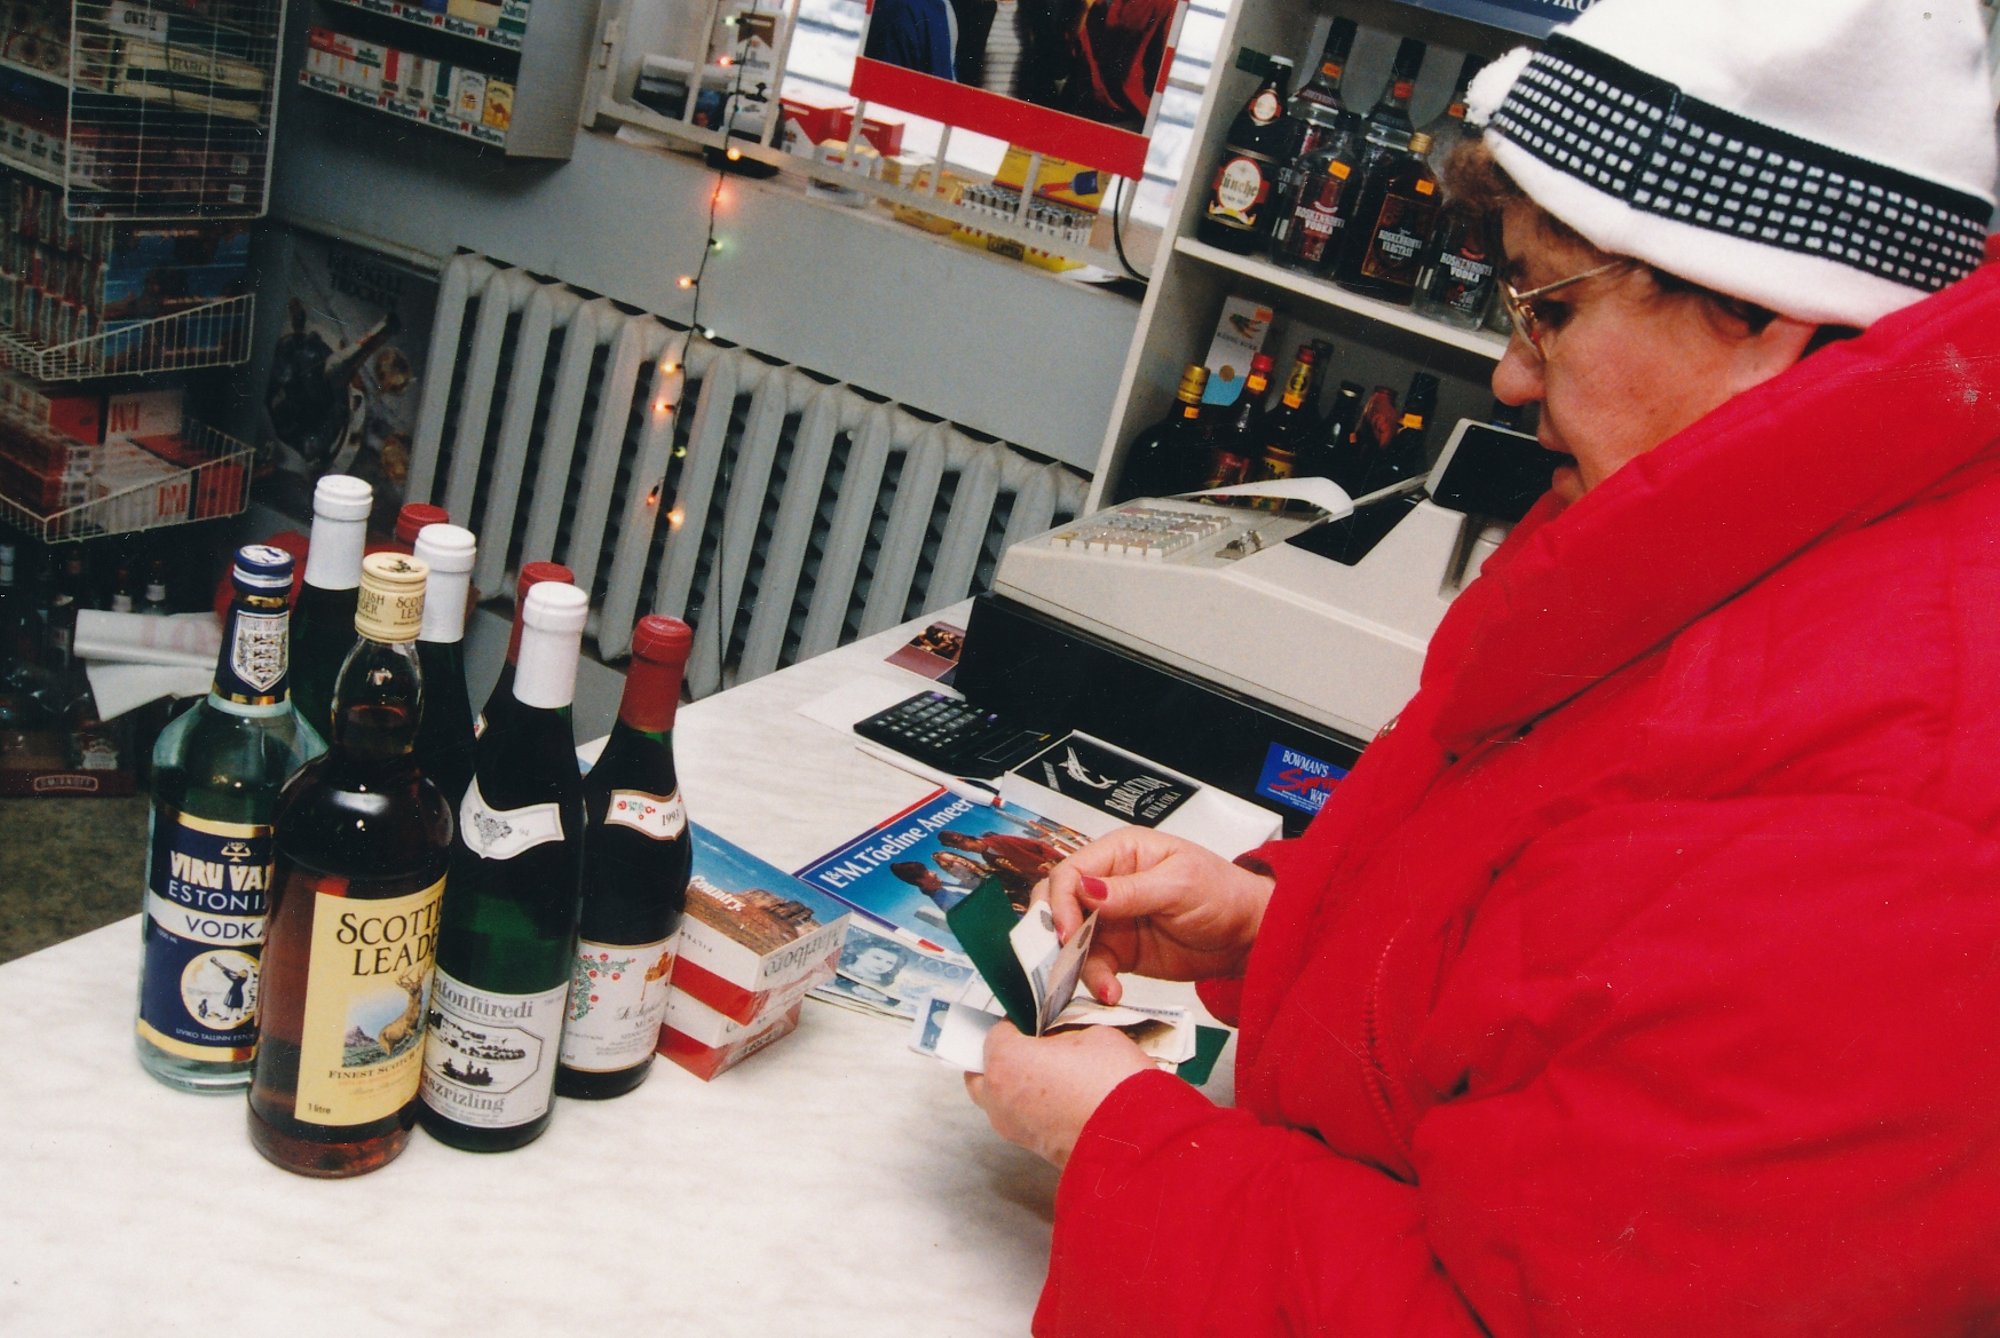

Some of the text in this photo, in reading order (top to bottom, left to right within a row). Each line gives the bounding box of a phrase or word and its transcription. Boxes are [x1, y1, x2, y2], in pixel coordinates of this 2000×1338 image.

[1450, 266, 1480, 284] VODKA
[1282, 750, 1329, 778] BOWMAN'S
[1104, 774, 1173, 817] BARRACUDA
[1310, 788, 1330, 807] WAT
[917, 799, 975, 833] Ameer
[170, 850, 224, 890] VIRU
[168, 880, 265, 910] ESTONI
[336, 895, 441, 945] SCOTTI
[352, 924, 440, 976] LEADE
[763, 933, 840, 977] Marlboro
[201, 1033, 231, 1041] TALLINN
[328, 1069, 374, 1079] FINEST
[314, 1103, 331, 1115] litre
